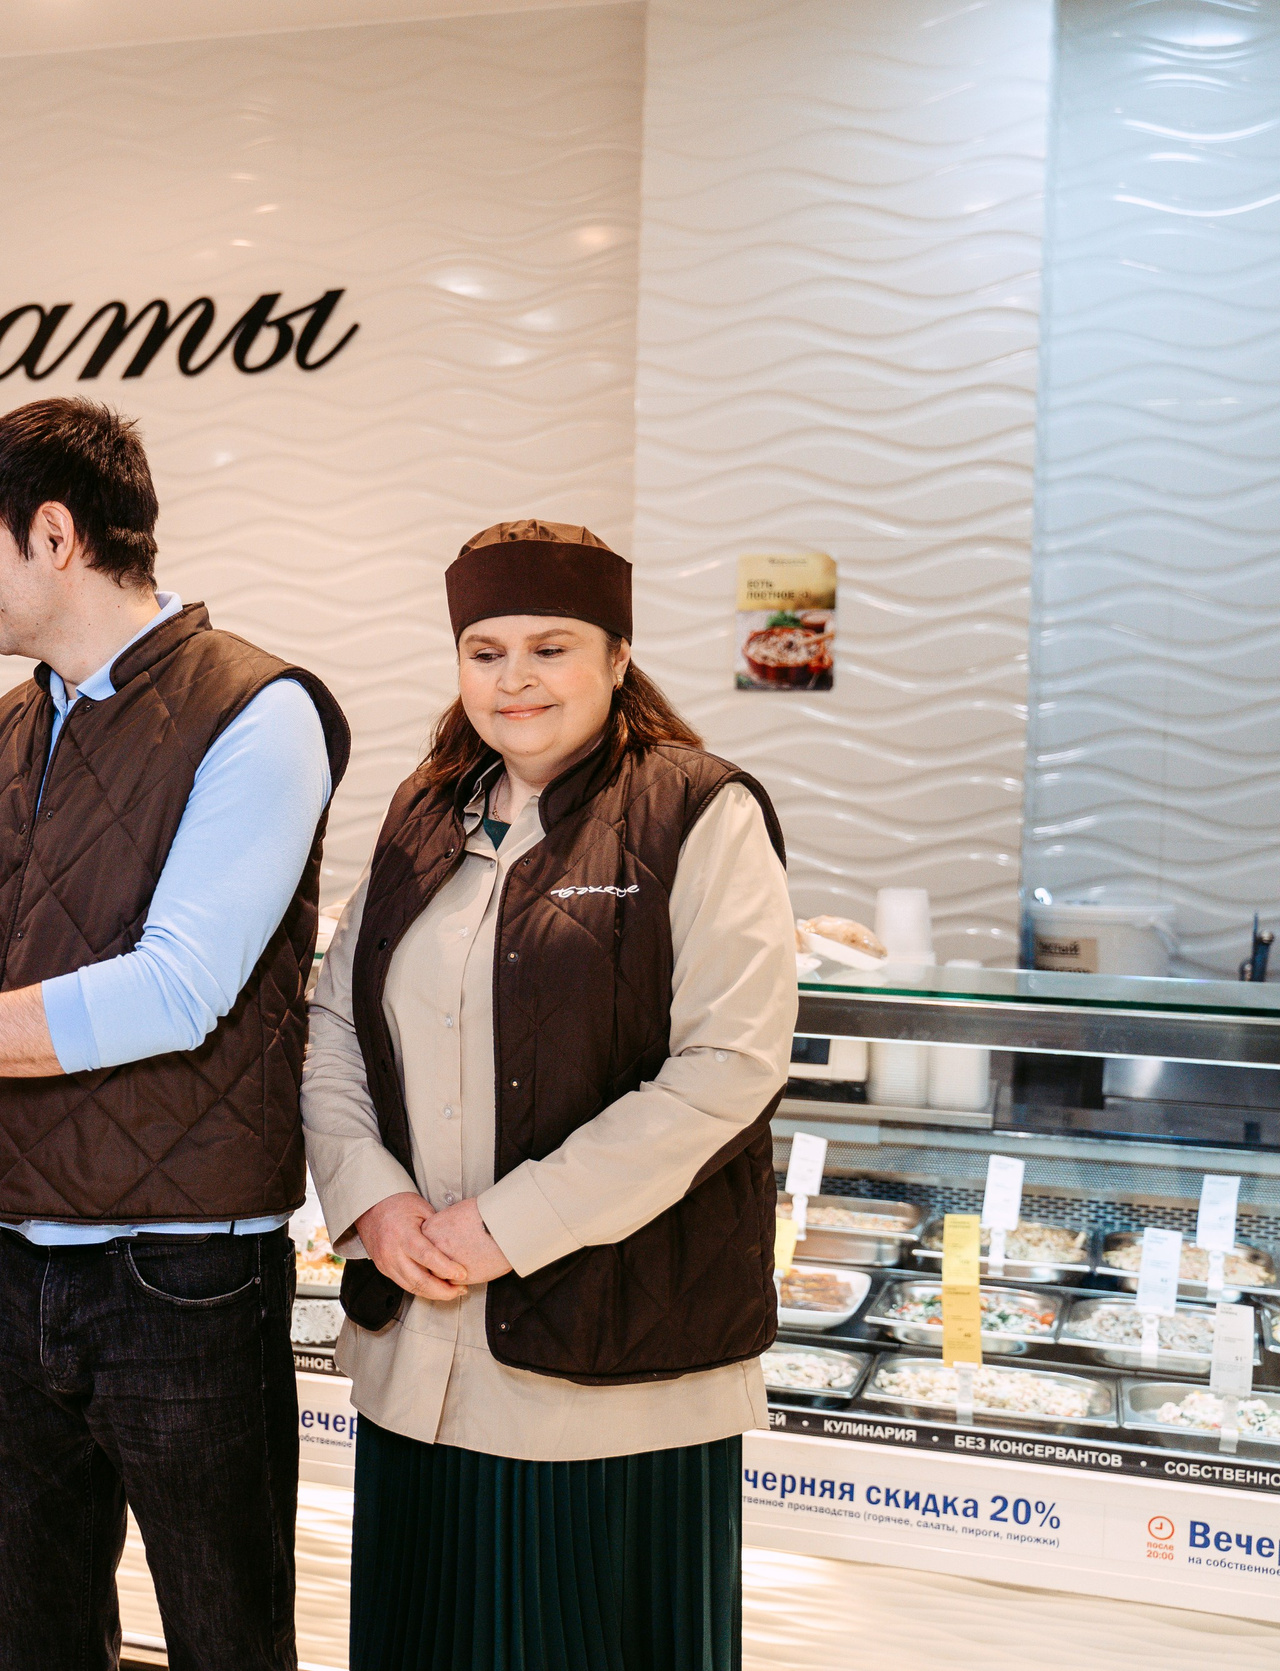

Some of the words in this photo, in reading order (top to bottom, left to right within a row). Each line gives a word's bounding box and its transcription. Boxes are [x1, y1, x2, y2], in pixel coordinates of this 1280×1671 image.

[823, 1419, 917, 1442] КУЛИНАРИЯ
[954, 1435, 986, 1452] БЕЗ
[989, 1439, 1123, 1468] КОНСЕРВАНТОВ
[743, 1468, 855, 1502] черняя
[865, 1485, 980, 1518] скидка
[989, 1495, 1062, 1531] 20%
[787, 1501, 861, 1519] производство
[863, 1511, 913, 1527] (горячее,
[916, 1519, 958, 1534] салаты,
[961, 1526, 1003, 1540] пироги,
[1006, 1532, 1060, 1549] пирожки)
[1146, 1541, 1175, 1551] после
[1189, 1520, 1280, 1566] Вече
[1146, 1549, 1175, 1561] 20:00
[1188, 1556, 1202, 1565] на
